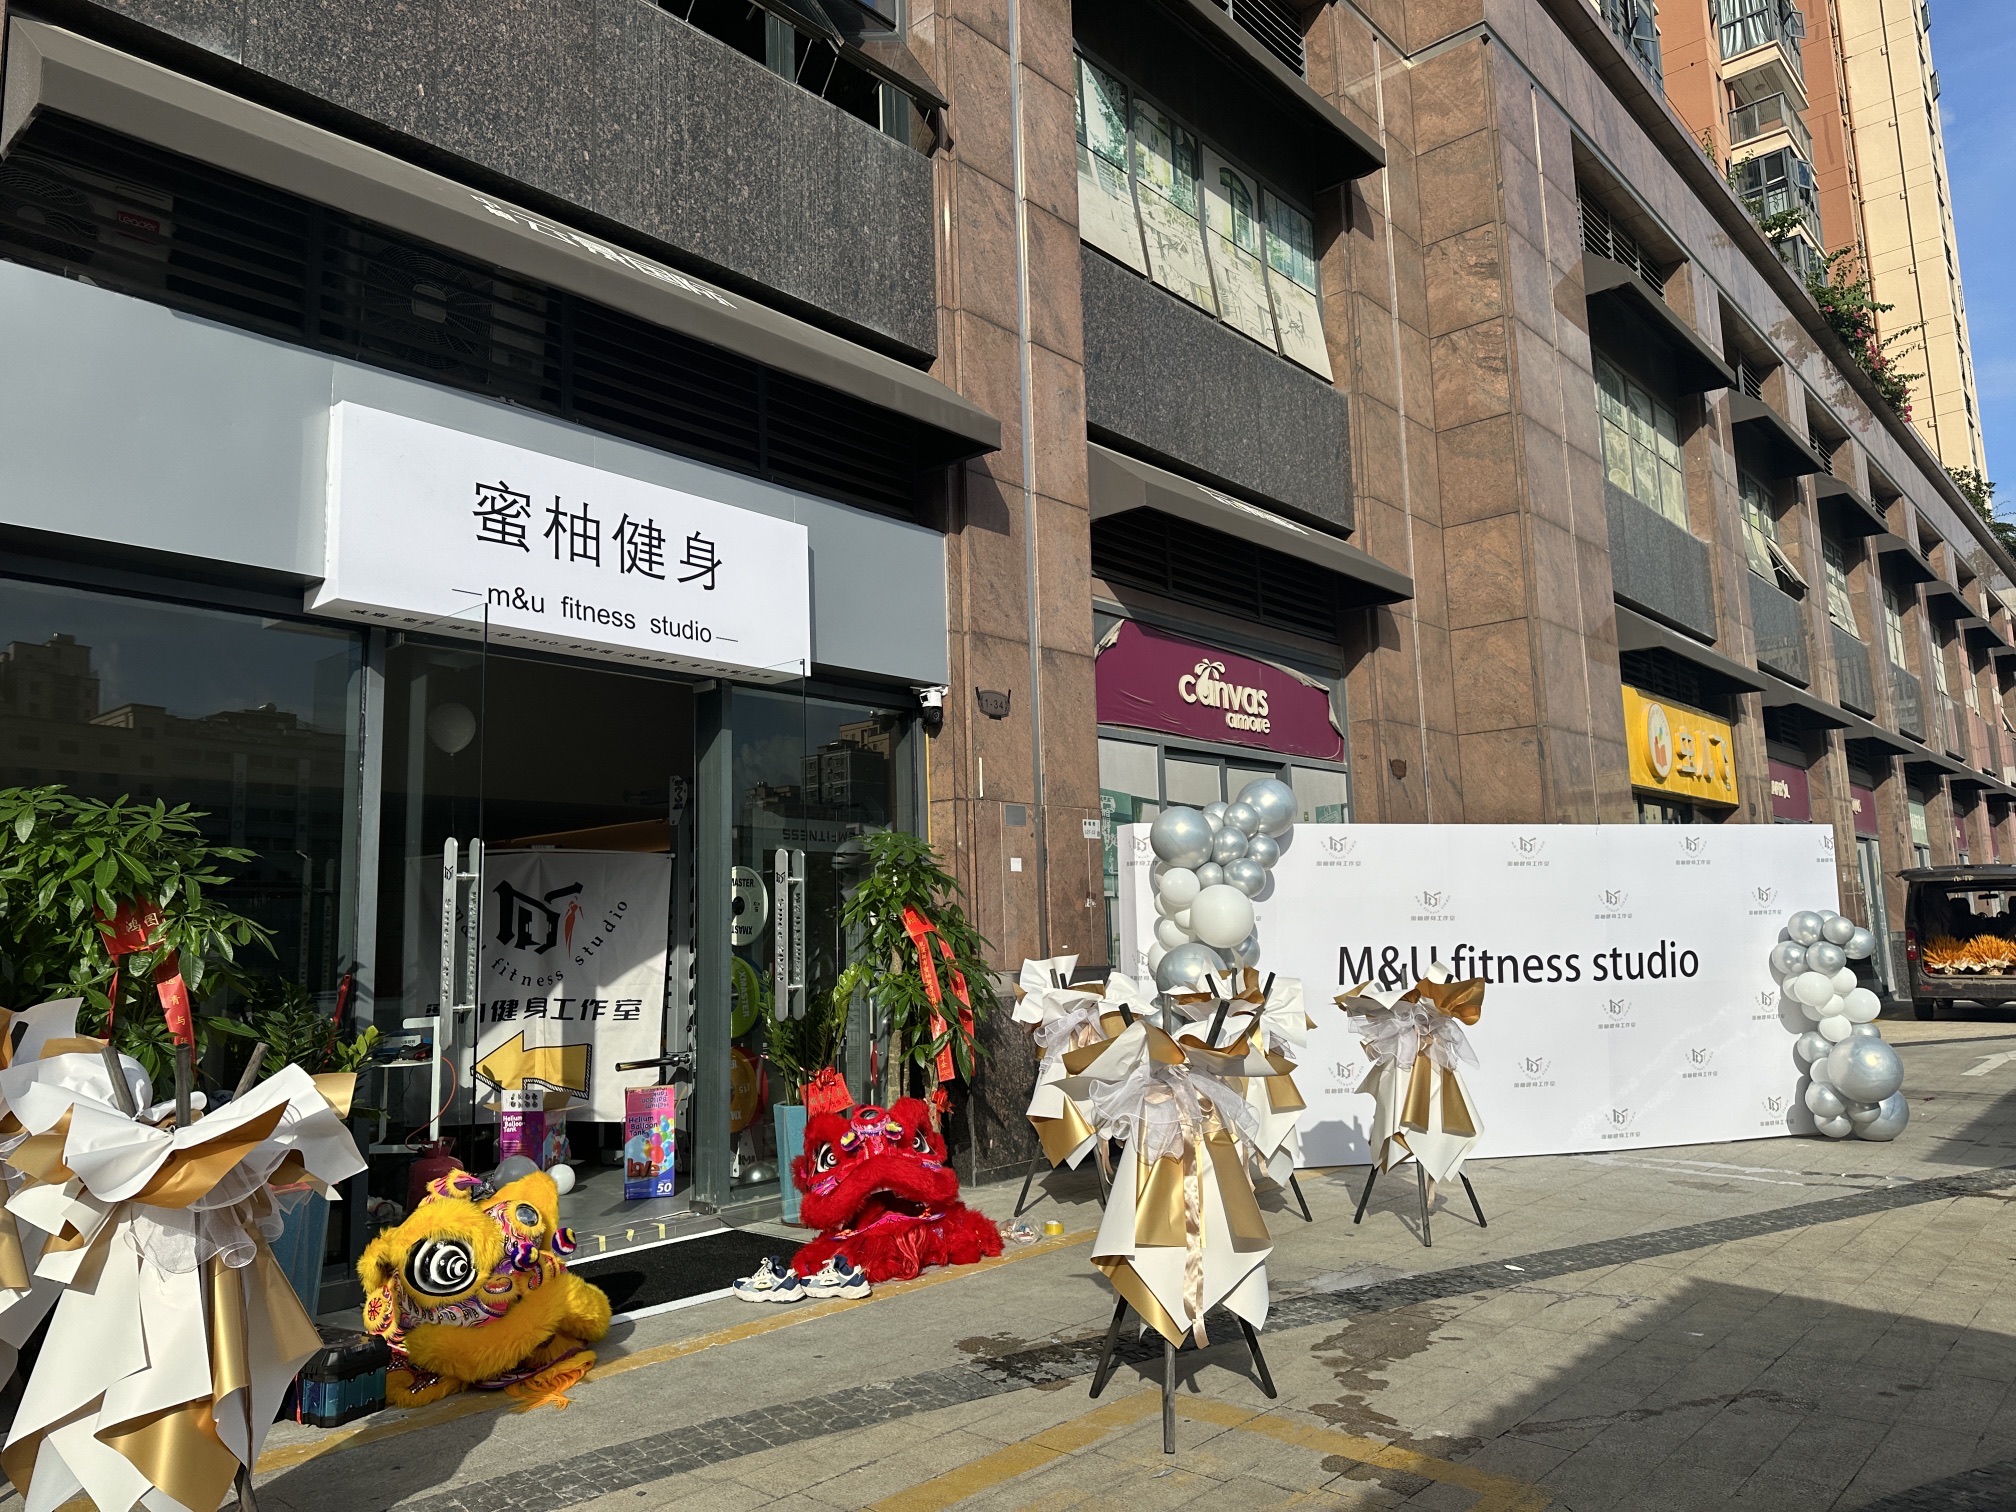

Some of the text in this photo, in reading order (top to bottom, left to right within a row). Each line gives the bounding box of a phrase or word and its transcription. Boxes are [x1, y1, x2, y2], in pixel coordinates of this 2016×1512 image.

[118, 213, 158, 232] Leader
[472, 480, 724, 591] 蜜柚健身
[488, 583, 712, 644] m&u fitness studio
[985, 698, 1004, 710] 1-34
[1178, 669, 1269, 717] canvas
[1226, 712, 1270, 733] amore
[732, 878, 754, 888] MASTER
[491, 957, 564, 987] fitness
[575, 899, 628, 966] studio
[1451, 943, 1581, 984] fitness
[1593, 939, 1699, 981] studio
[738, 970, 751, 1018] XMASTER
[426, 997, 643, 1024] 健身工作室
[630, 1122, 658, 1130] Balloon
[656, 1183, 672, 1193] 50
